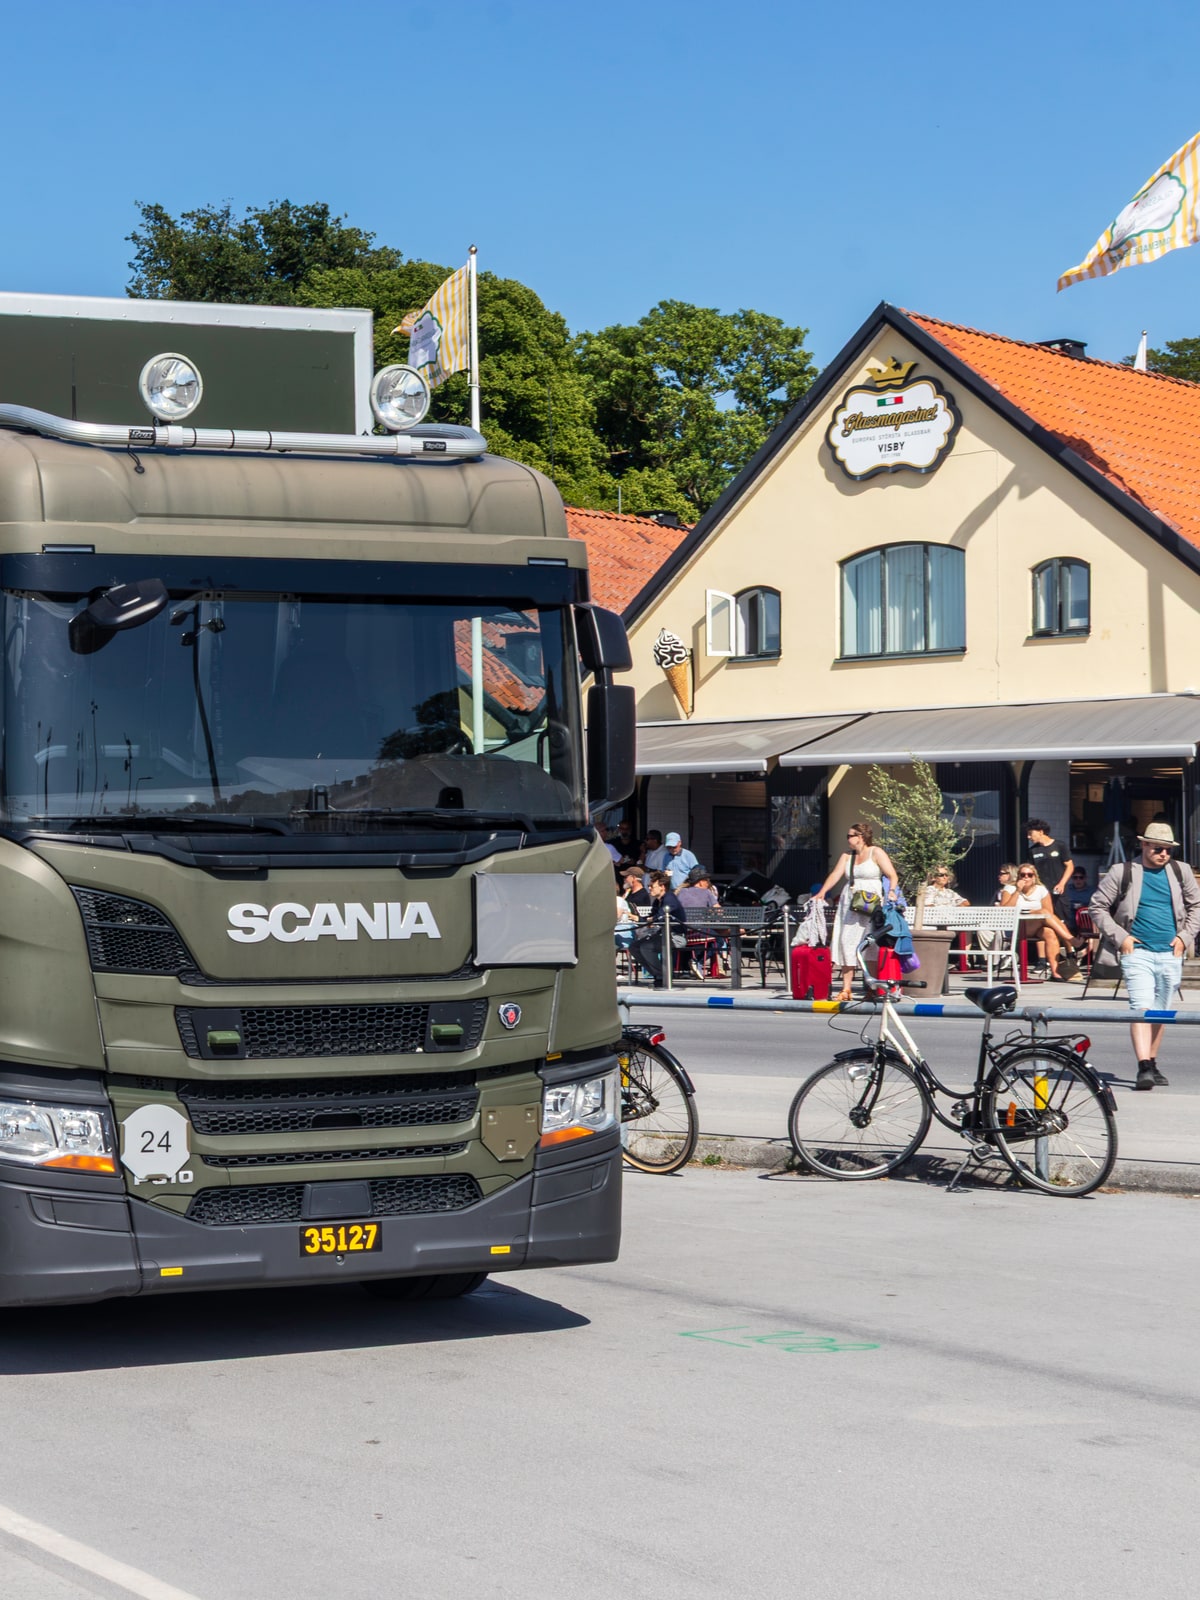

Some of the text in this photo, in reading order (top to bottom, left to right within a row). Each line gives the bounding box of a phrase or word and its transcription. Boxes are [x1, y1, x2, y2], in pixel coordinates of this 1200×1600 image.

[841, 403, 938, 438] Glassmagasinet
[878, 441, 905, 453] VISBY
[226, 902, 441, 943] SCANIA
[140, 1130, 172, 1153] 24
[304, 1224, 377, 1254] 35127
